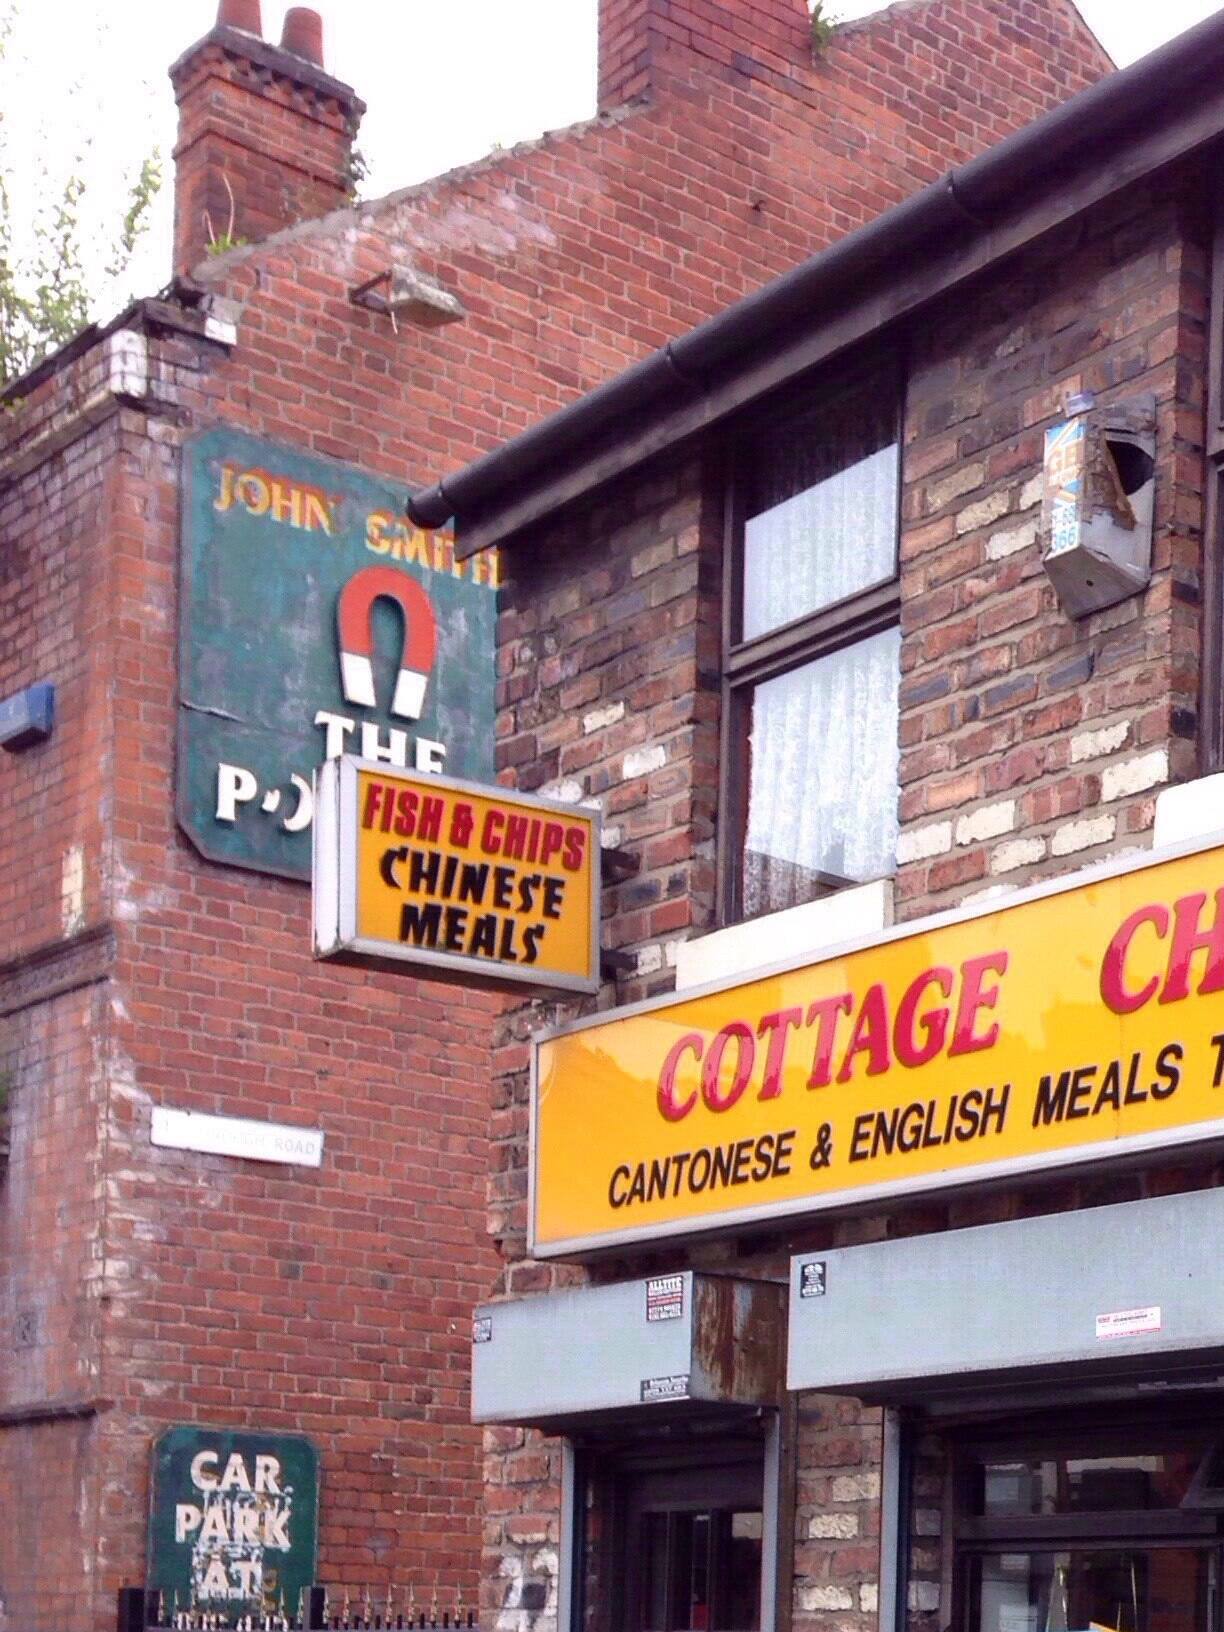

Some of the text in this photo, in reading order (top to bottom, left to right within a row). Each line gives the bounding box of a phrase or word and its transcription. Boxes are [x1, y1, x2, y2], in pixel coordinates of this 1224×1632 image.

[213, 462, 340, 537] JOHN
[314, 710, 447, 773] THE
[362, 783, 587, 872] FISH & CHIPS
[379, 846, 566, 920] CHINESE
[399, 902, 546, 964] MEALS
[657, 952, 1009, 1123] COTTAGE
[608, 1131, 796, 1209] CANTONESE
[810, 1123, 833, 1170] &
[849, 1085, 1011, 1163] ENGLISH
[1033, 1044, 1184, 1127] MEALS
[190, 1450, 282, 1495] CAR
[175, 1503, 291, 1550] PARK
[198, 1557, 264, 1601] AT
